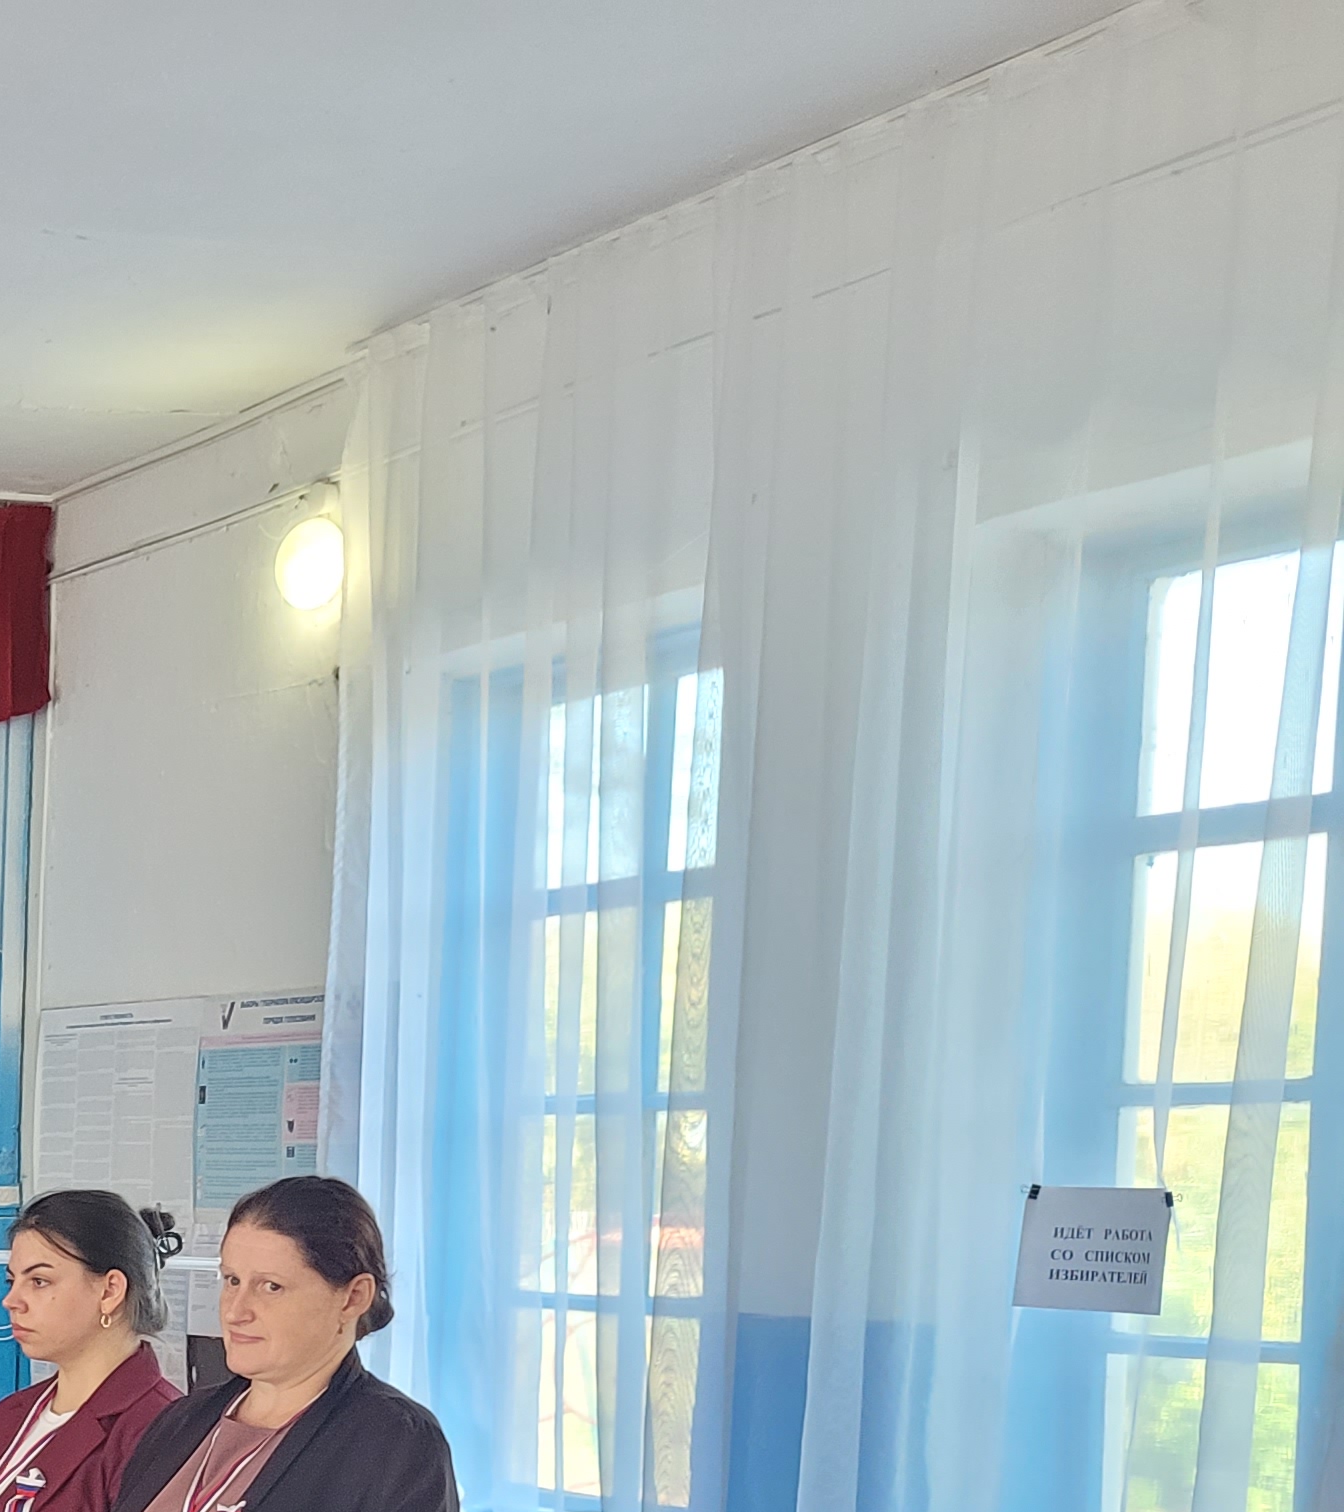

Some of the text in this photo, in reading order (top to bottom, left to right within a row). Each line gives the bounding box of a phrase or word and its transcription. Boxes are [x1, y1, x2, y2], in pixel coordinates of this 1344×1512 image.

[1053, 1224, 1153, 1242] ИДЁТ РАБОТА
[1050, 1248, 1151, 1265] СО СПИСКОМ
[1048, 1267, 1148, 1286] ИЗБИРАТЕЛЕЙ
